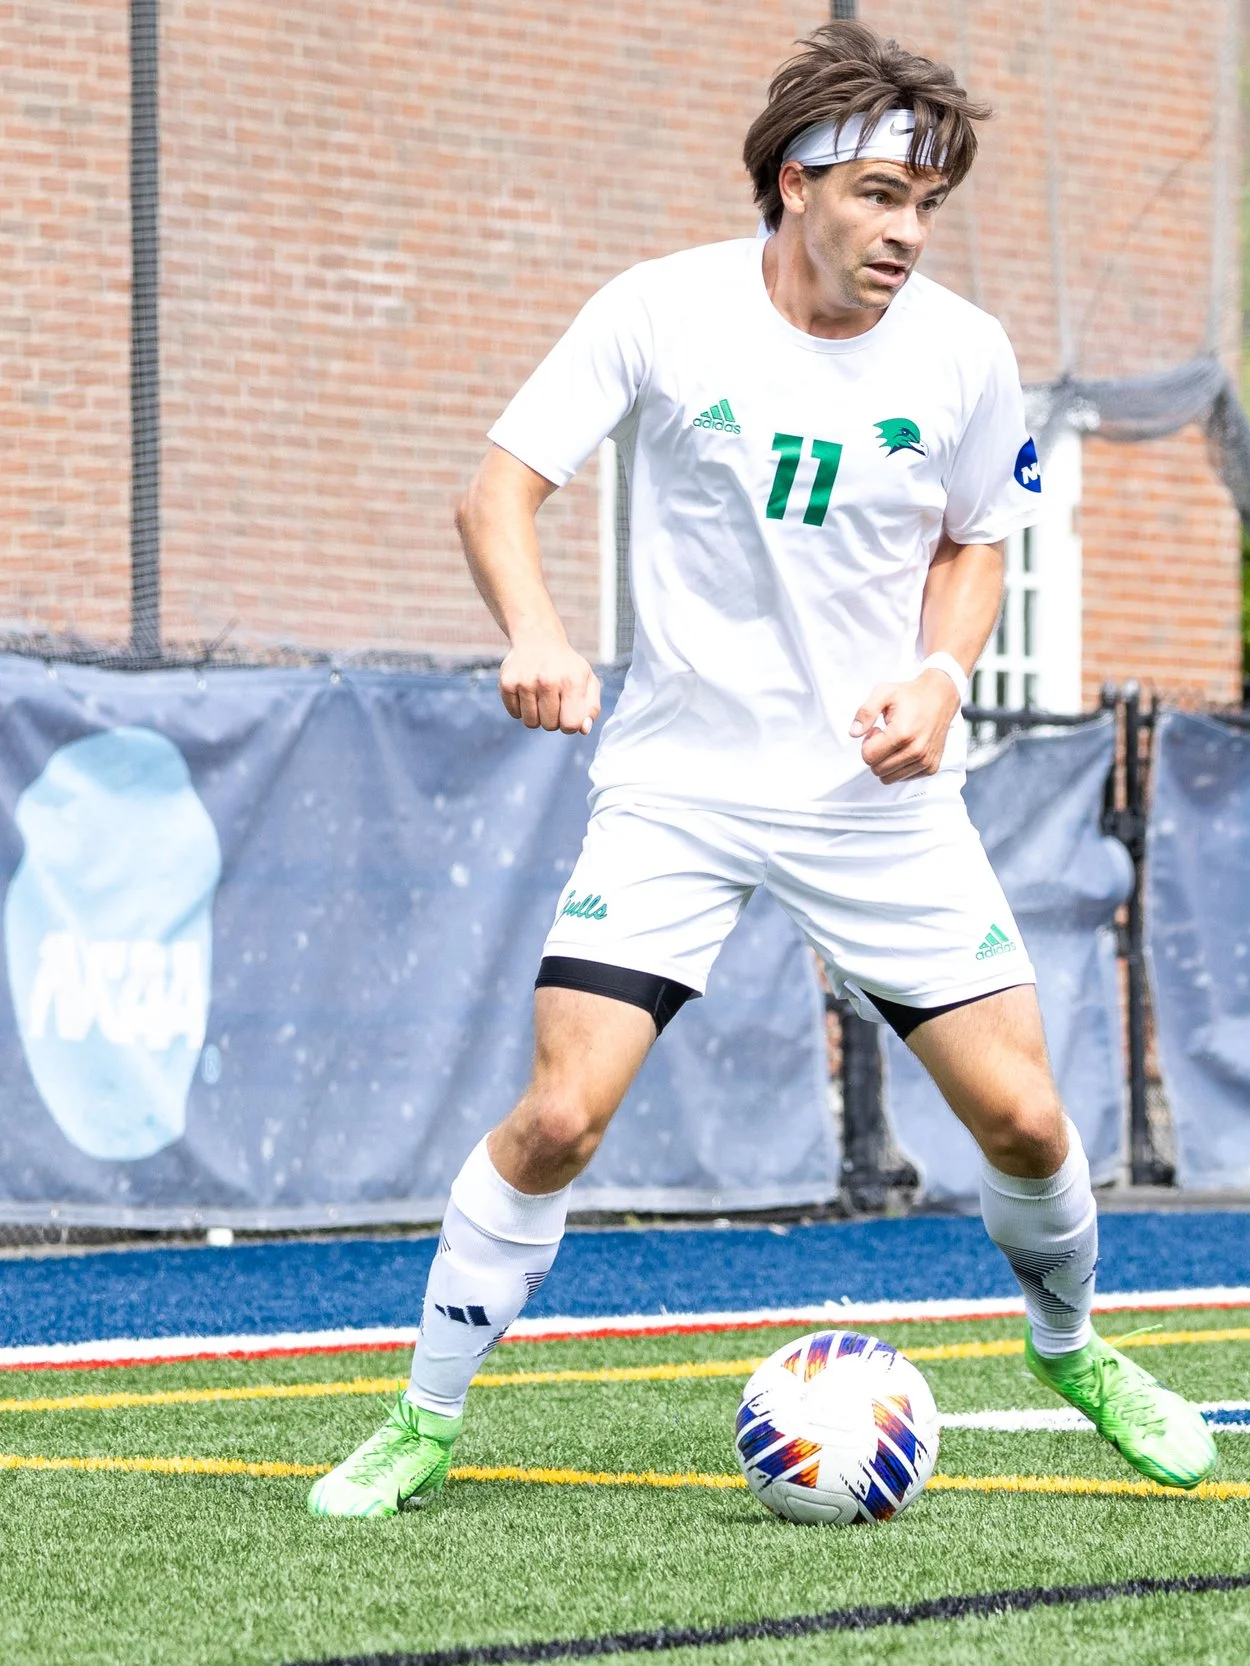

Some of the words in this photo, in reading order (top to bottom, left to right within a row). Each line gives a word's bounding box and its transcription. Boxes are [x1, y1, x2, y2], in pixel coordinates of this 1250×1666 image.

[692, 417, 742, 435] adidas
[766, 432, 843, 527] 11
[975, 941, 1017, 961] adidas
[28, 932, 205, 1051] NCAA
